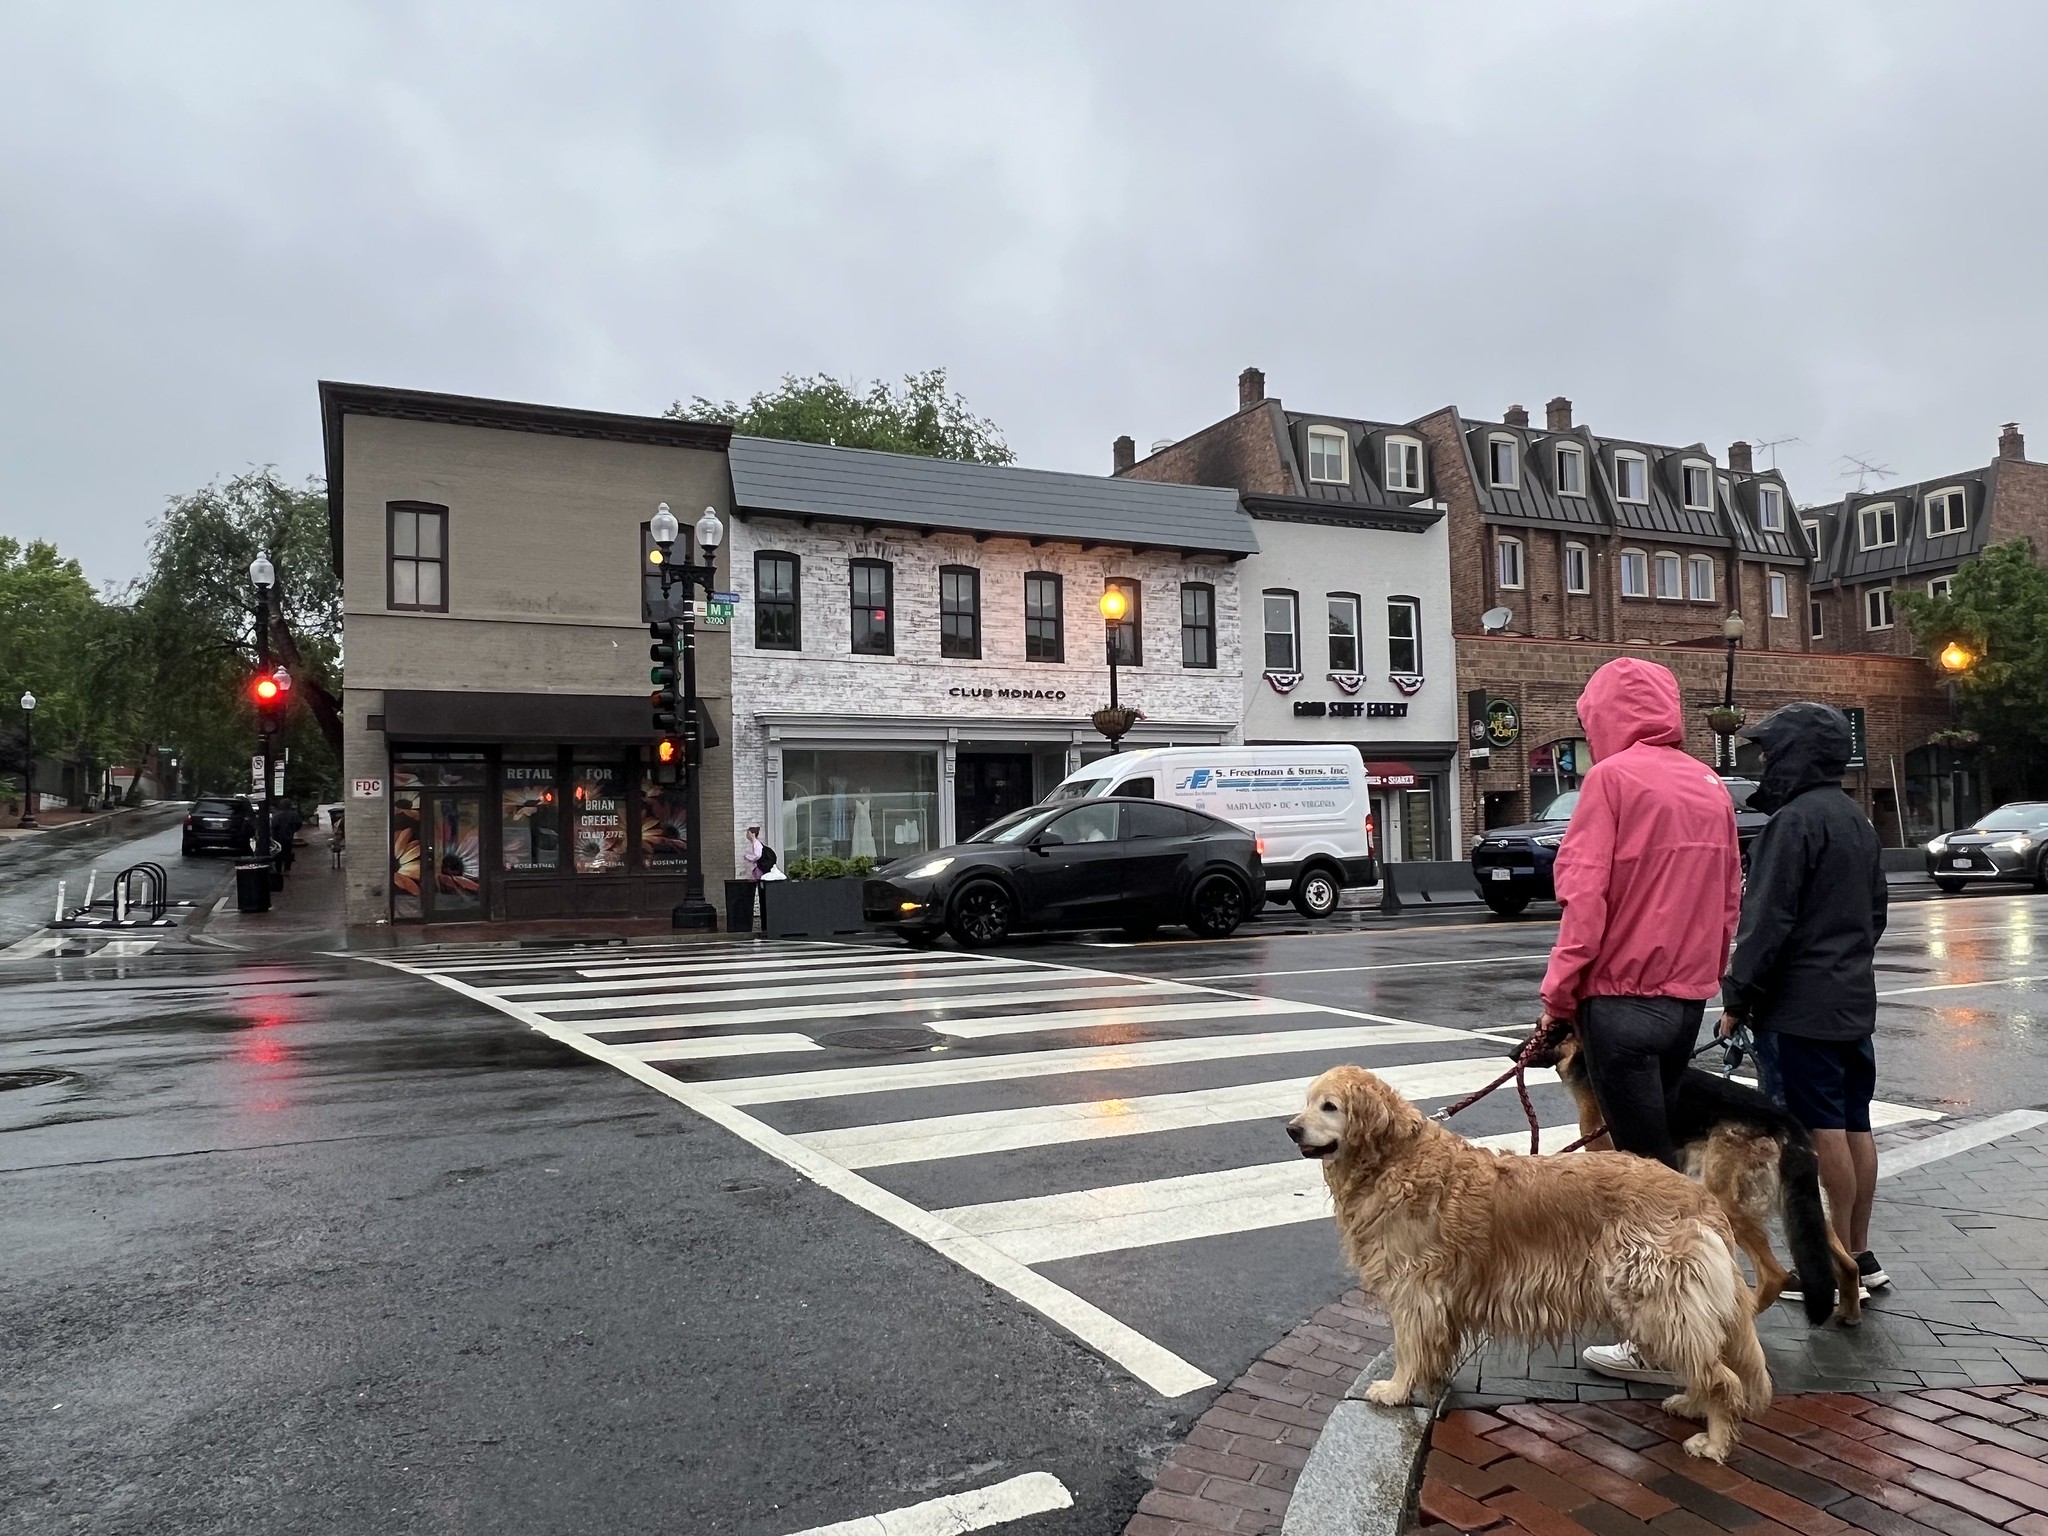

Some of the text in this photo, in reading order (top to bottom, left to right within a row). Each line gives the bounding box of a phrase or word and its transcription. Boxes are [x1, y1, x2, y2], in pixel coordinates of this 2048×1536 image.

[710, 603, 721, 616] M
[705, 616, 725, 624] 3200
[949, 687, 1066, 699] CLUB MONACO
[507, 768, 613, 780] RETAIL FOR
[1229, 768, 1284, 777] Freedman
[1287, 768, 1295, 776] &
[1330, 766, 1348, 775] Inc.
[356, 780, 380, 791] FDC
[585, 799, 615, 811] BRIAN
[1226, 802, 1272, 810] MARYLAND
[1301, 800, 1336, 808] VIRGINIA
[581, 815, 619, 826] GREENE
